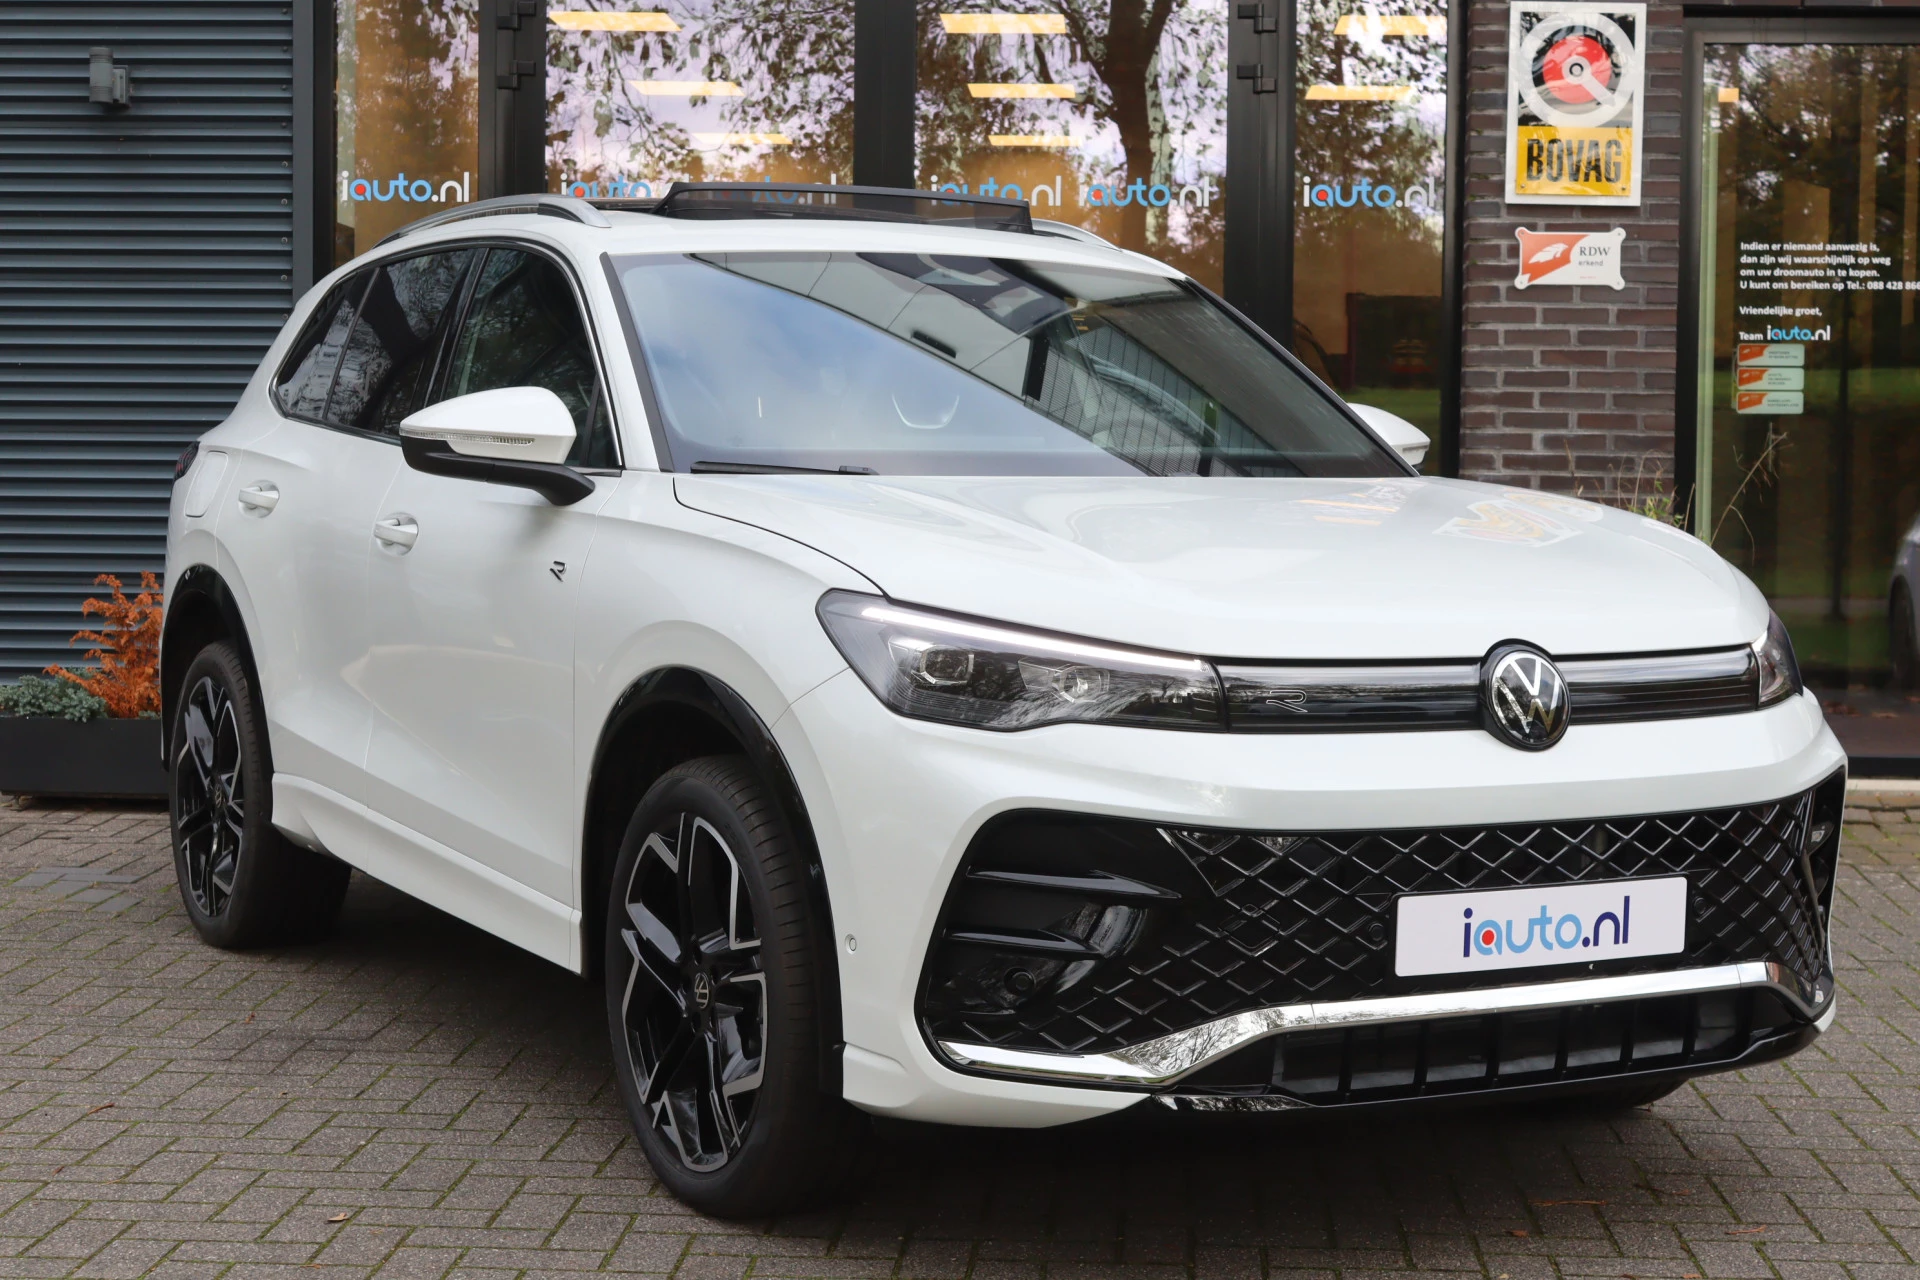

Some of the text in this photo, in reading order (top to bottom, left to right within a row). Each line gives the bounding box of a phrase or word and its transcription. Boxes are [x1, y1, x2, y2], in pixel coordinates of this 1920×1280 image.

[1526, 138, 1622, 183] BOVAG
[341, 171, 470, 203] iauto.nl
[930, 174, 1062, 206] iautonl
[1079, 175, 1210, 207] iauto.nl
[1303, 176, 1435, 208] iauto.nl
[1580, 246, 1612, 256] RDW
[1741, 242, 1769, 251] Indien
[1783, 242, 1823, 251] niemand
[1825, 242, 1868, 253] aanwezig
[1870, 242, 1880, 252] is,
[1578, 259, 1604, 267] erkend
[1740, 254, 1891, 266] dan zijn wij waarschijnlijk op weg
[1773, 267, 1825, 277] droomauto
[1826, 268, 1836, 277] in
[1837, 268, 1847, 277] te
[1849, 268, 1880, 279] kopen.
[1740, 281, 1748, 290] U
[1749, 280, 1770, 290] kunt
[1772, 282, 1789, 290] ons
[1790, 280, 1830, 290] bereiken
[1832, 283, 1845, 291] op
[1867, 281, 1884, 290] 088
[1886, 281, 1903, 290] 428
[1739, 306, 1822, 317] Vriendelijke groet,
[1739, 325, 1831, 341] Team iauto.nl
[1463, 895, 1630, 958] iauto.nl
